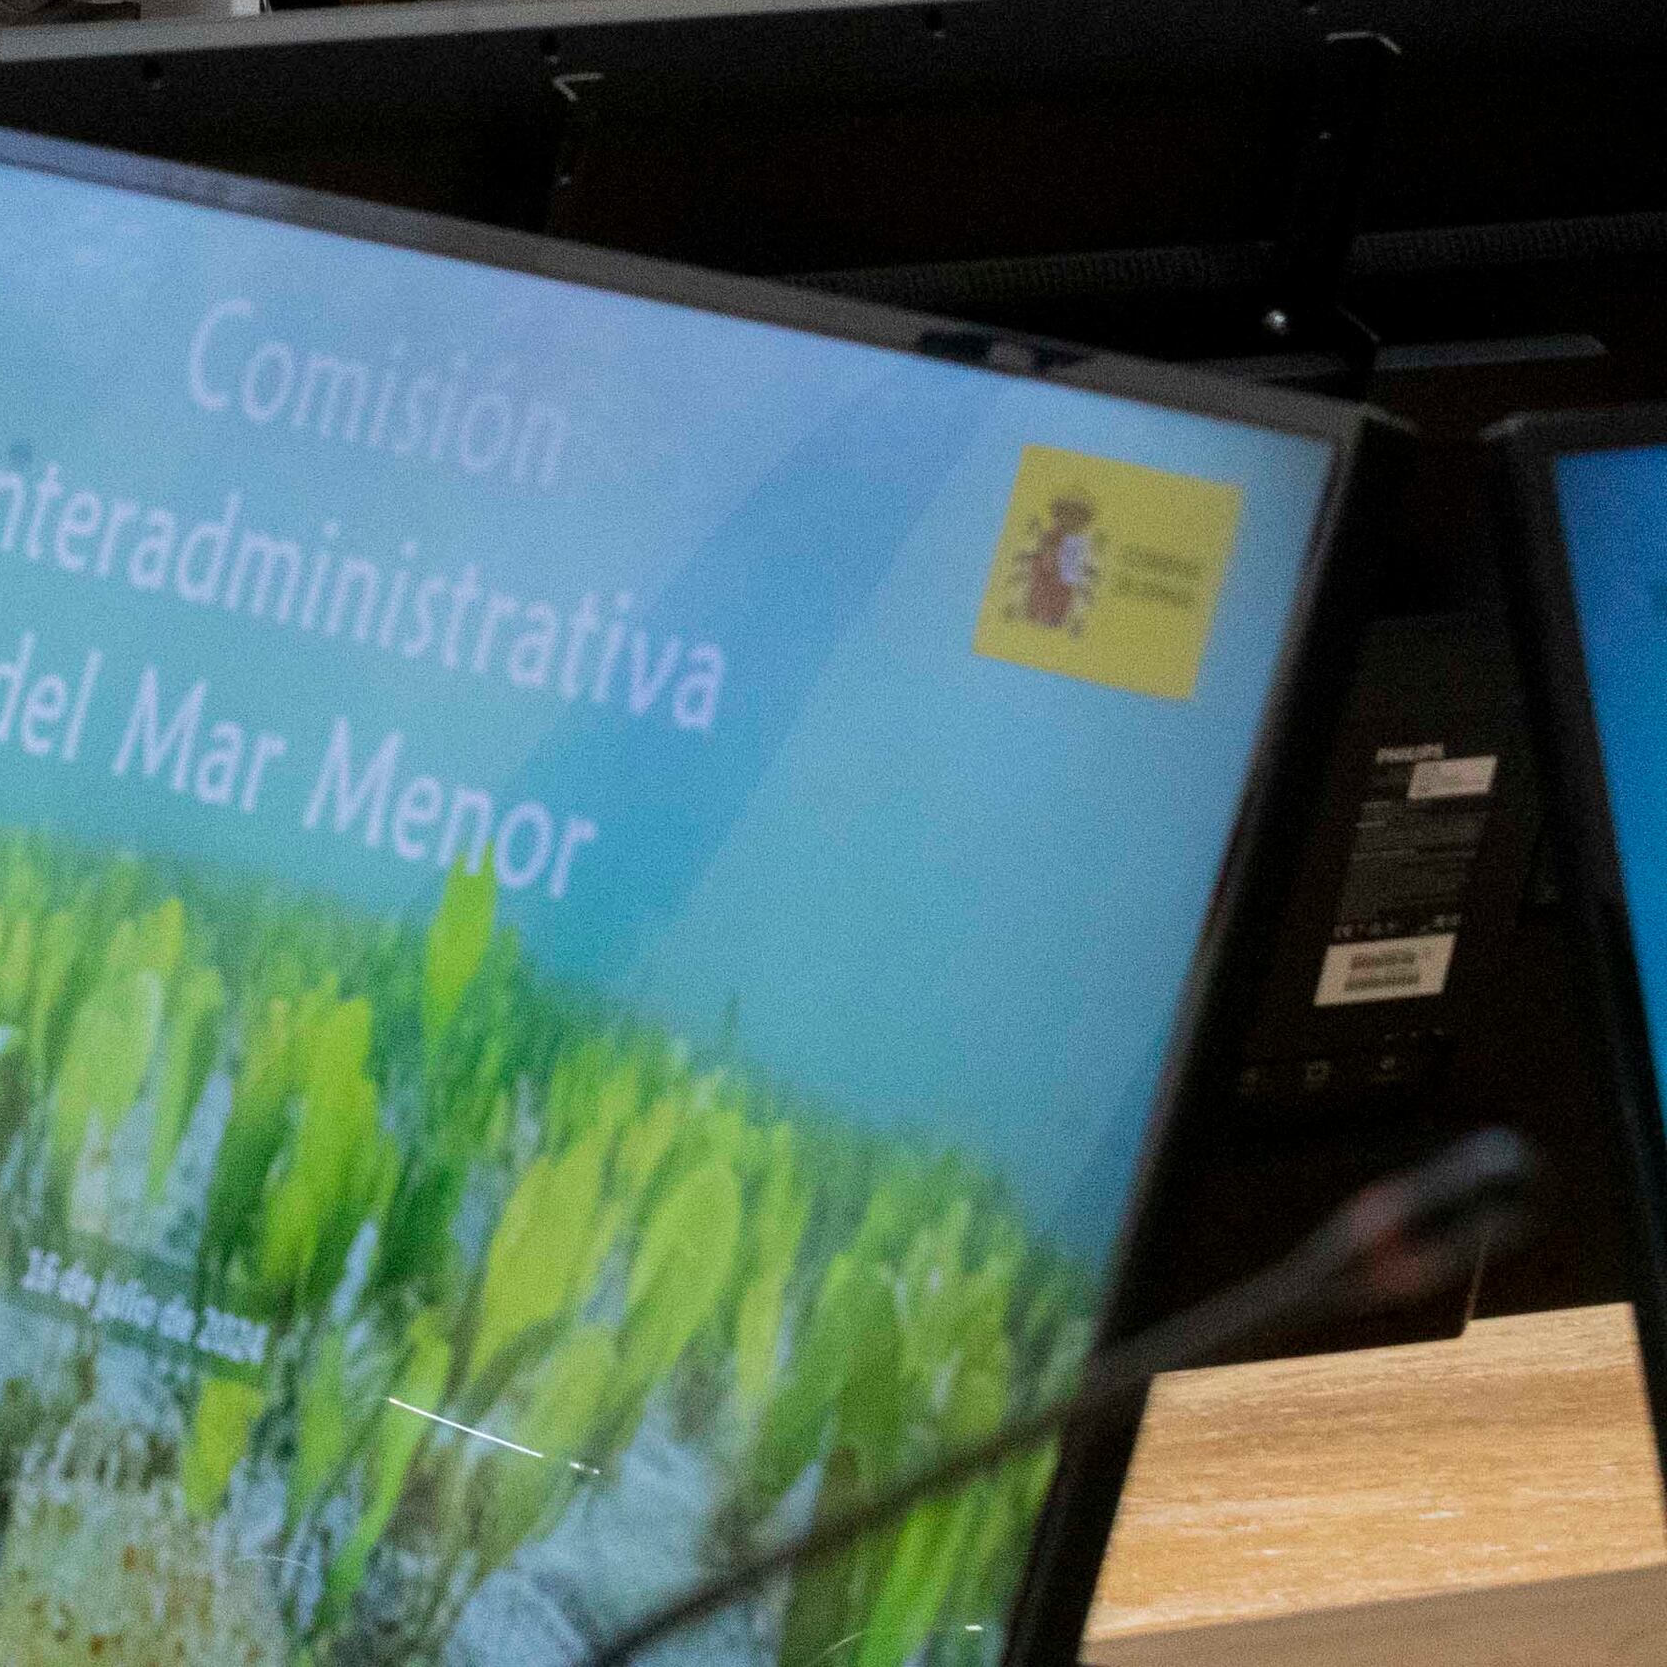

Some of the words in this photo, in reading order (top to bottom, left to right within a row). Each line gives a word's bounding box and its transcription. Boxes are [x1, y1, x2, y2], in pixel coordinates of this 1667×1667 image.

[187, 298, 570, 488] Comisión
[111, 665, 287, 814] Mar
[303, 716, 599, 900] Menor
[91, 1271, 159, 1330] julio
